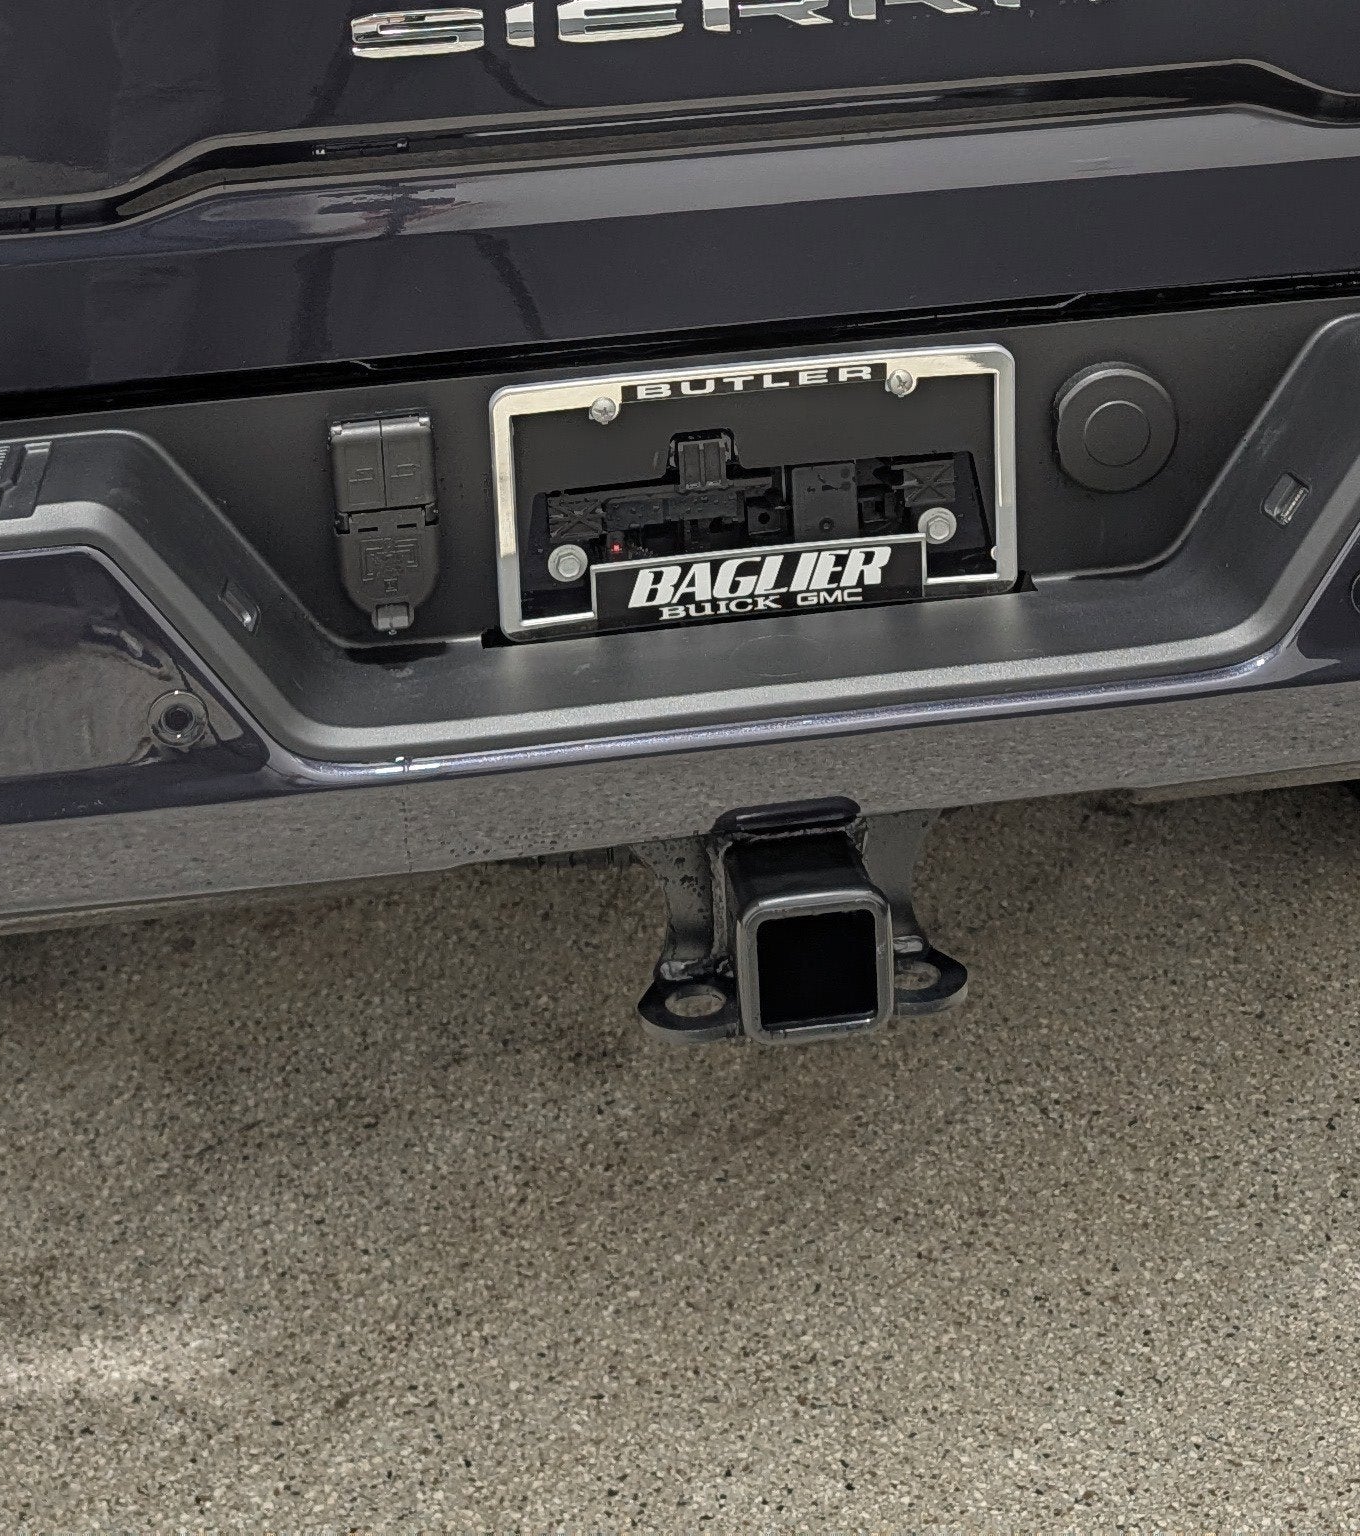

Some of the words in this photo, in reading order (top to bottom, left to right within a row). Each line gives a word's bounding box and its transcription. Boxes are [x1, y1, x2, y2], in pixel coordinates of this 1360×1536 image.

[636, 365, 872, 400] BUTLER
[628, 546, 891, 609] BAGLIER
[658, 594, 782, 621] BUICK
[796, 587, 863, 606] GMC
